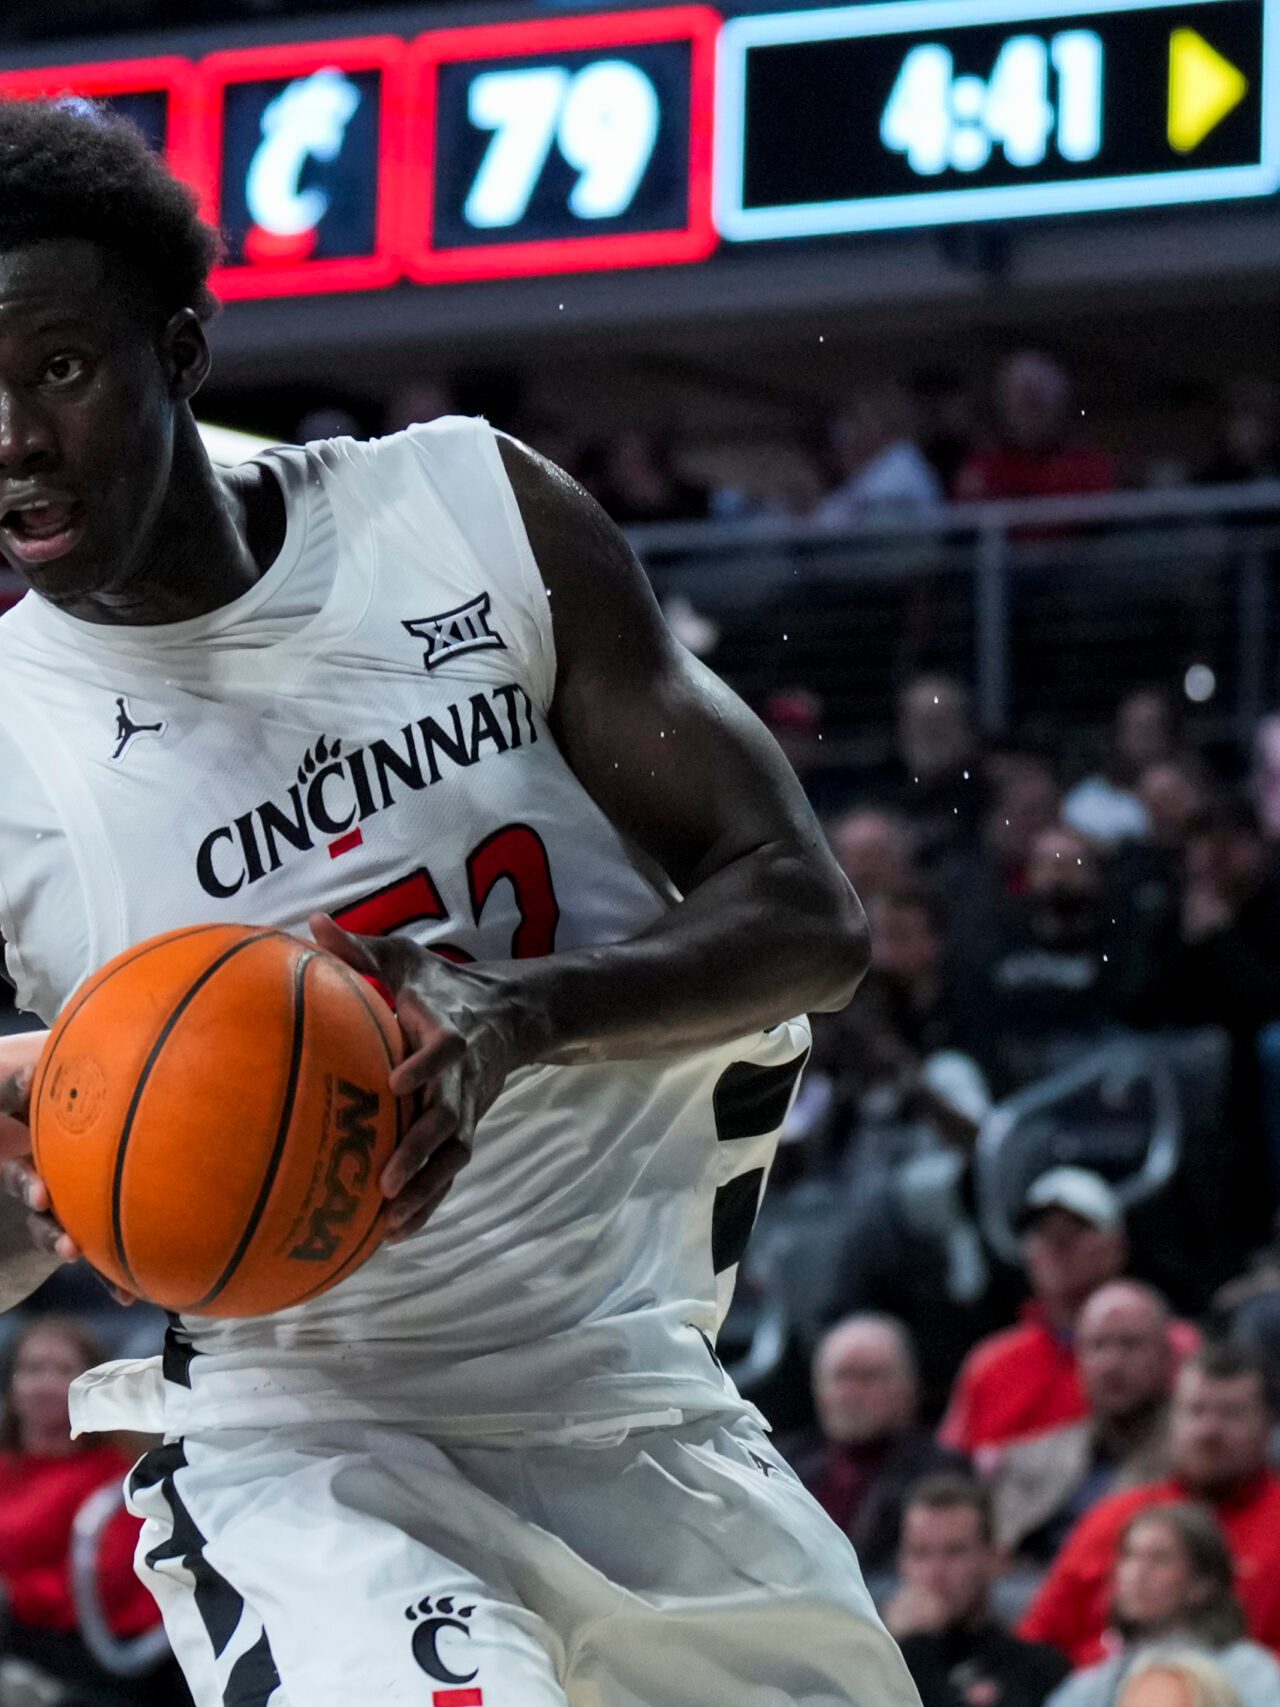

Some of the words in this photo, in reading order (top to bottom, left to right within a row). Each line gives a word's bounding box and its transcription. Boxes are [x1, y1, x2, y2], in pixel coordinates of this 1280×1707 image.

[464, 59, 659, 228] 79
[880, 29, 1103, 174] 4:41
[288, 1077, 380, 1261] NCAA
